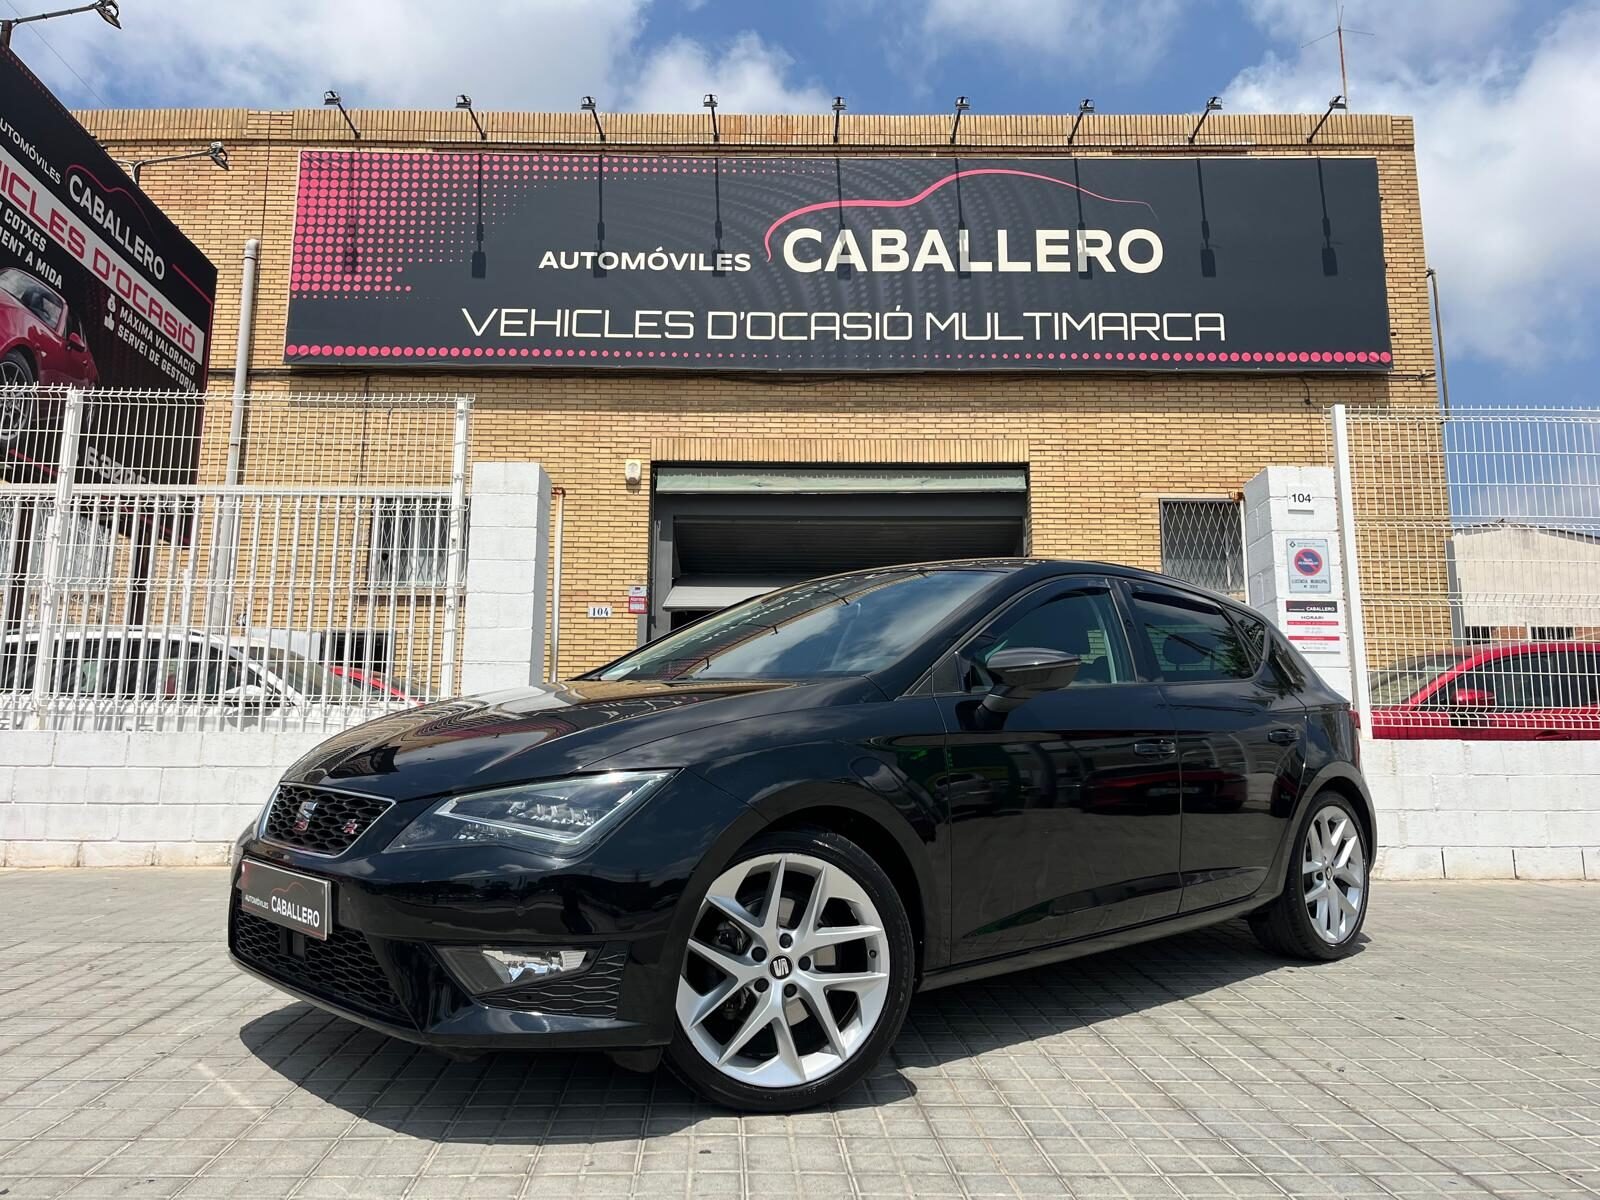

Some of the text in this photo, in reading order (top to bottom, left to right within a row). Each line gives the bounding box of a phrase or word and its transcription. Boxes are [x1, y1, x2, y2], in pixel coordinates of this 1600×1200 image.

[0, 116, 165, 280] UTOMÓVILES CABALLERO
[4, 207, 47, 253] COTXES
[538, 228, 1164, 274] AUTOMÓVILES CABALLERO
[0, 158, 195, 355] ICLES D'OCASIÓ
[25, 250, 33, 267] A
[36, 256, 63, 290] MIDA
[461, 305, 1226, 341] VEHICLES D'OCASIÓ MULTIMARCA
[117, 323, 197, 394] SERVEI DE GESTORIA
[155, 334, 197, 376] VALORACIÓ
[1291, 493, 1312, 503] 104
[592, 607, 609, 617] 104
[271, 895, 320, 928] CABALLERO
